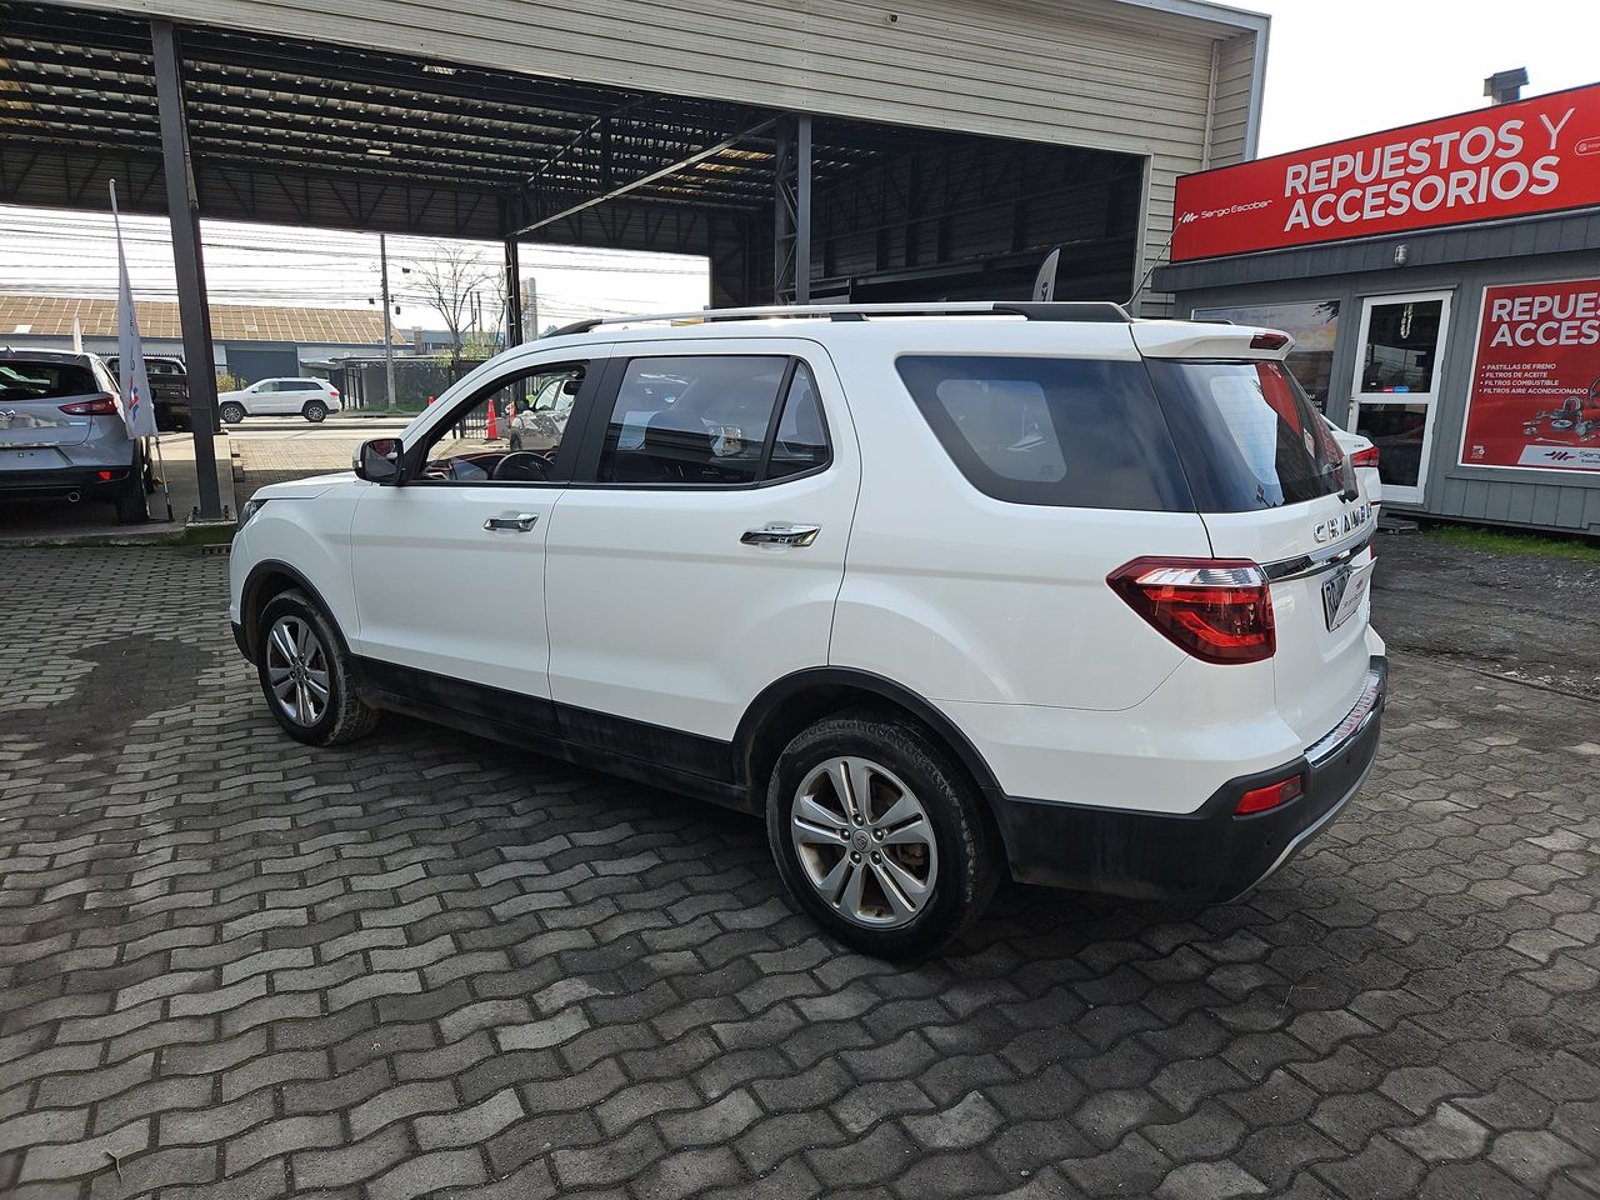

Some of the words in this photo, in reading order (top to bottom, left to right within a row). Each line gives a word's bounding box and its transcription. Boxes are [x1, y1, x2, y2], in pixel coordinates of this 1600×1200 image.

[1284, 120, 1525, 198] REPUESTOS
[1540, 107, 1576, 151] Y
[1283, 155, 1561, 232] ACCESORIOS
[1491, 292, 1600, 322] REPUE
[1527, 387, 1589, 395] ACONDICIONADO
